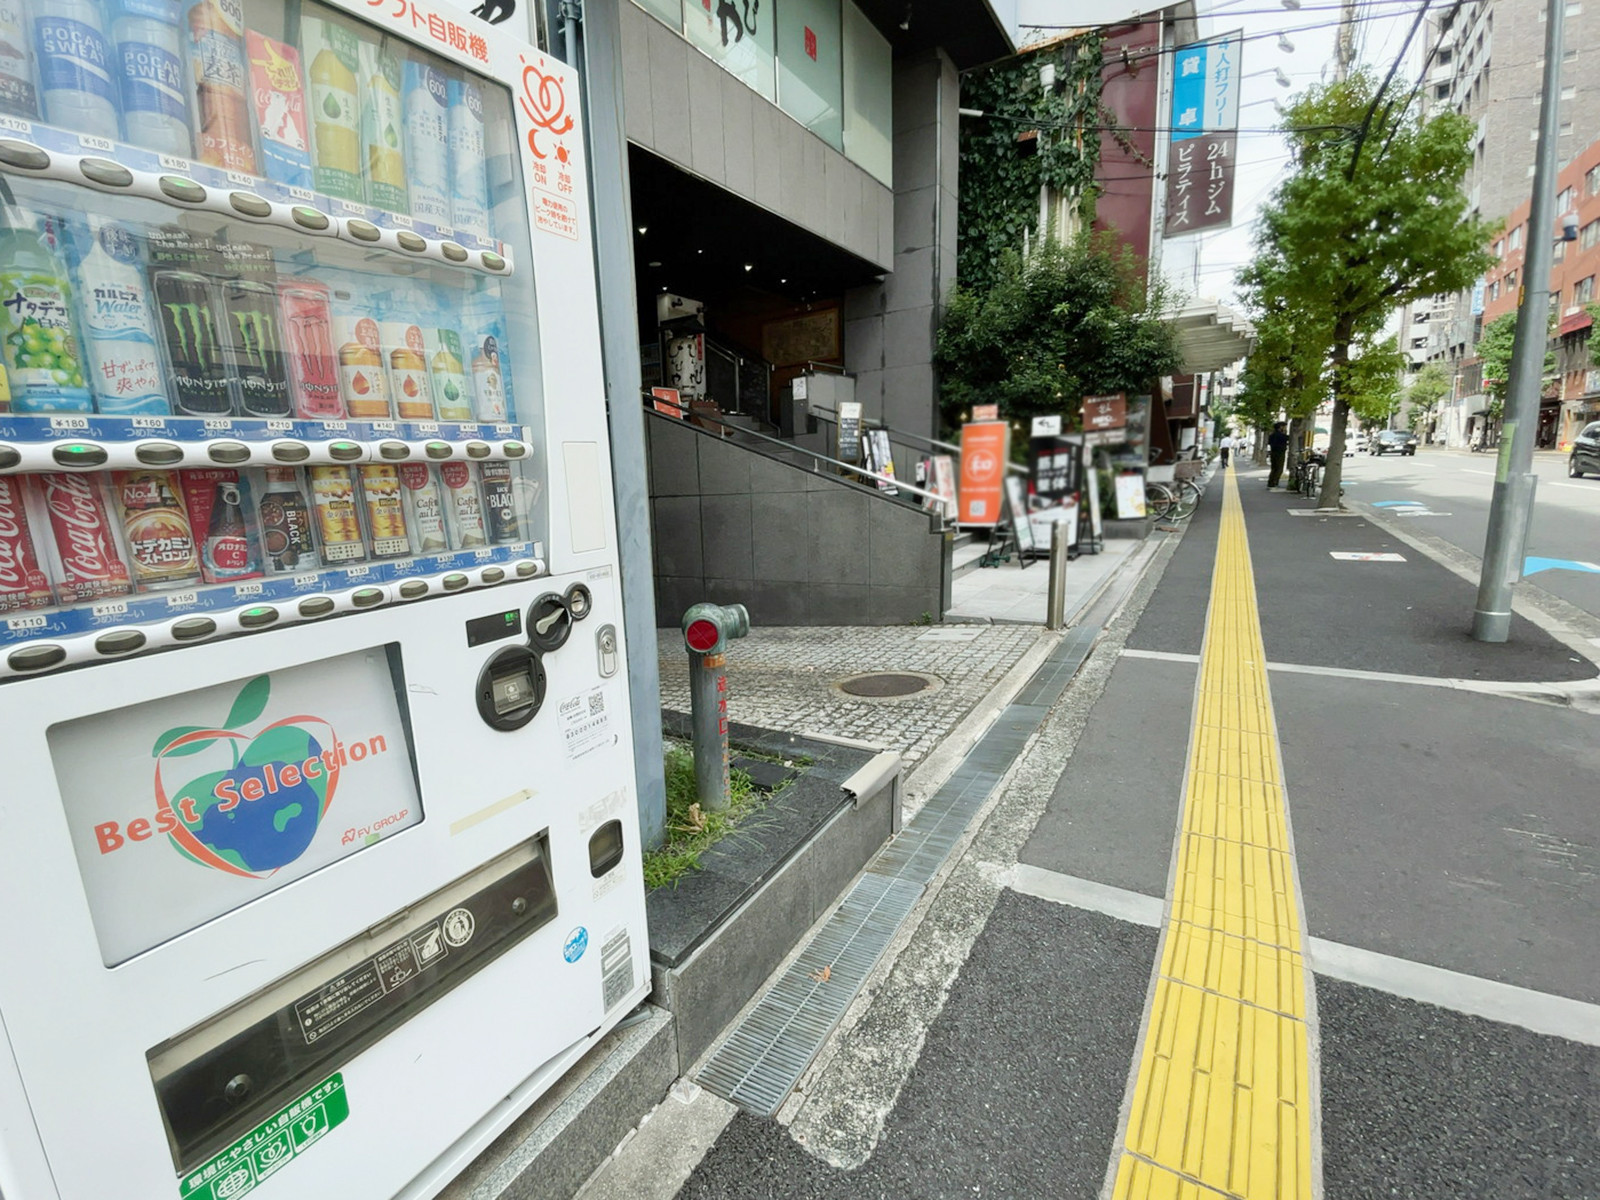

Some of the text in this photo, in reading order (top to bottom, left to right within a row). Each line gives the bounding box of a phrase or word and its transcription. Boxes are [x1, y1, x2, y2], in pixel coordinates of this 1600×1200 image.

[368, 0, 489, 63] フト自販機
[534, 172, 548, 186] ON
[1173, 143, 1195, 227] ピラティス
[557, 182, 574, 195] OFF
[95, 299, 142, 315] Water
[55, 419, 85, 428] ¥180
[135, 418, 162, 427] ¥160
[206, 420, 229, 429] ¥210
[269, 421, 290, 430] ¥210
[285, 510, 302, 545] BLACK
[130, 537, 192, 554] ドデカミン
[232, 551, 240, 560] C
[96, 604, 124, 614] ¥110
[11, 618, 43, 628] ¥110
[93, 734, 388, 855] Best Selection
[372, 808, 409, 832] GROUP
